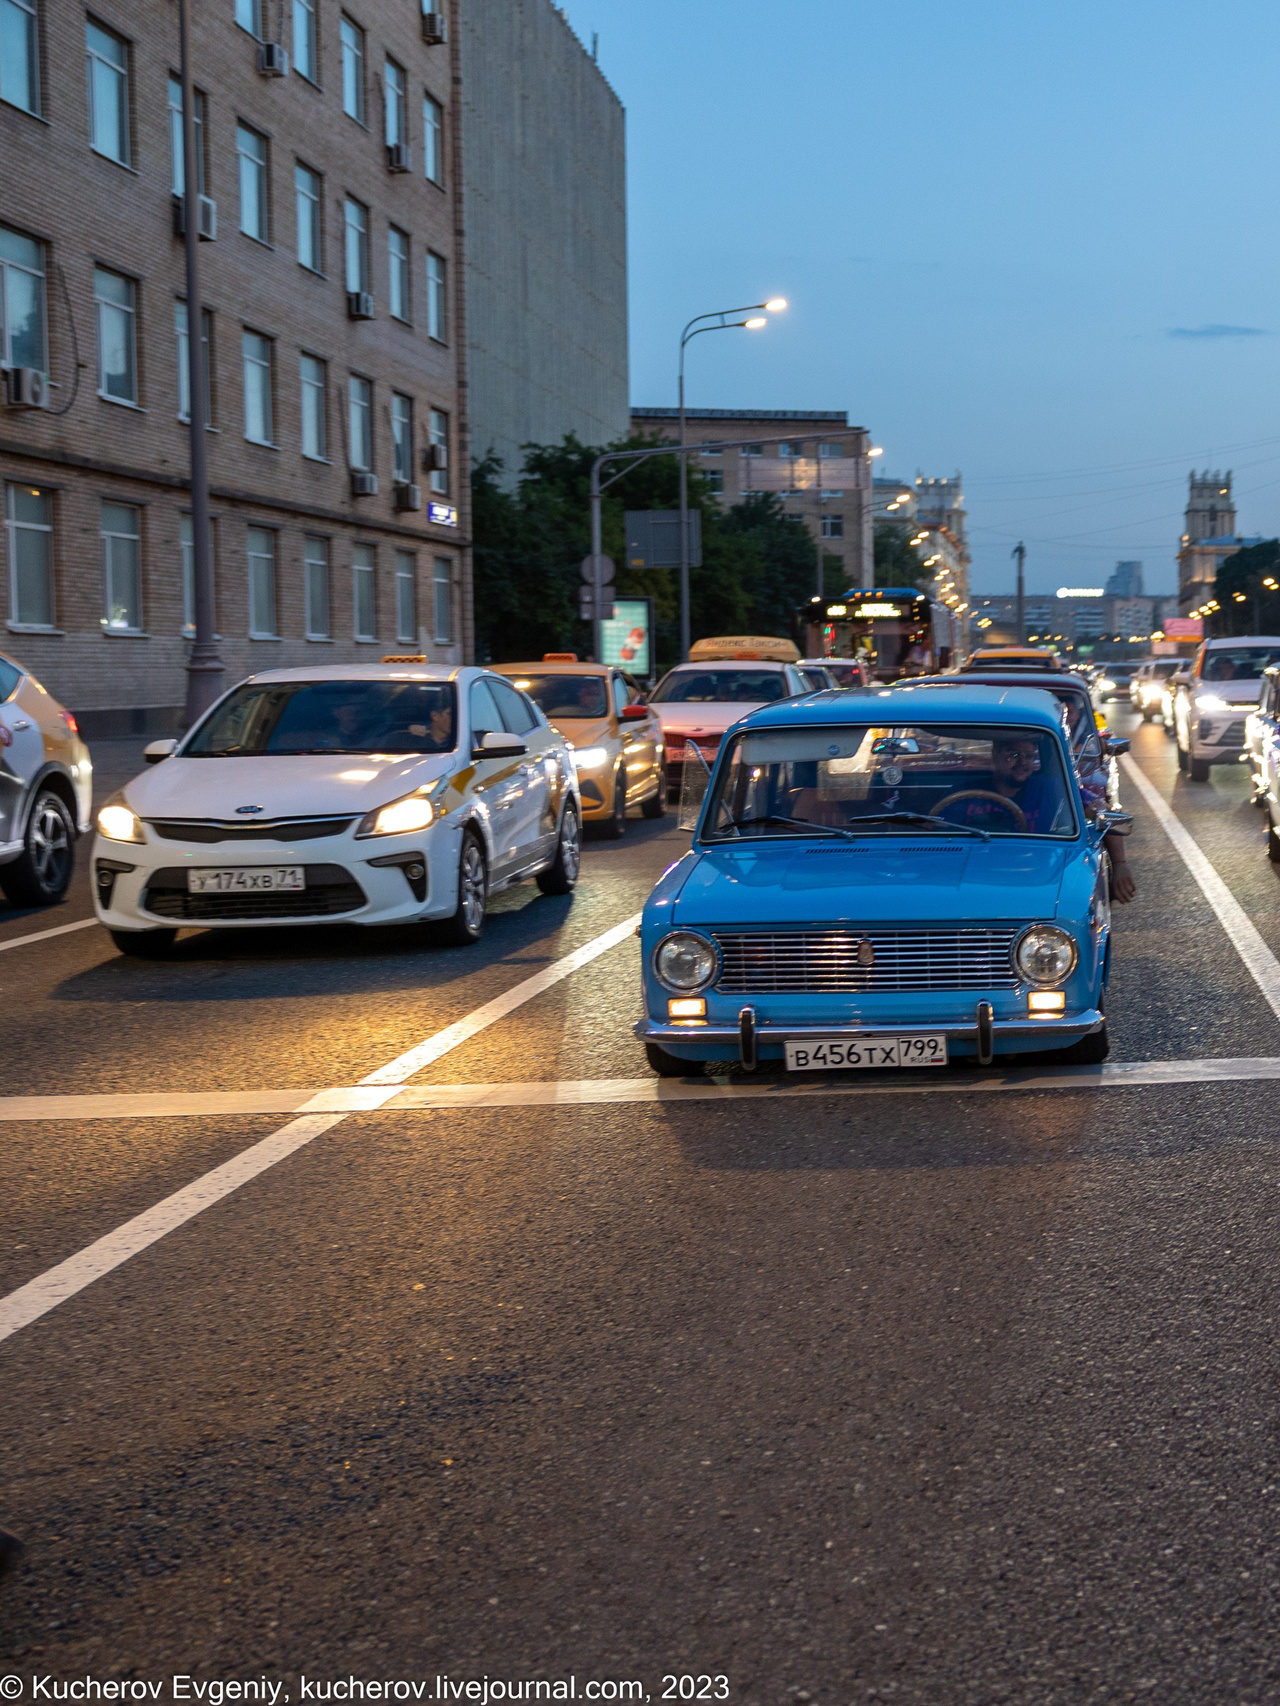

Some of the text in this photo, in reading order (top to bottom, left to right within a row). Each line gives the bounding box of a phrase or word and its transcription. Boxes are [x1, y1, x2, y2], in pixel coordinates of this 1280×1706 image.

[197, 870, 297, 890] У174ХВ 71
[795, 1038, 939, 1067] В456ТХ 799
[909, 1056, 931, 1064] RUS
